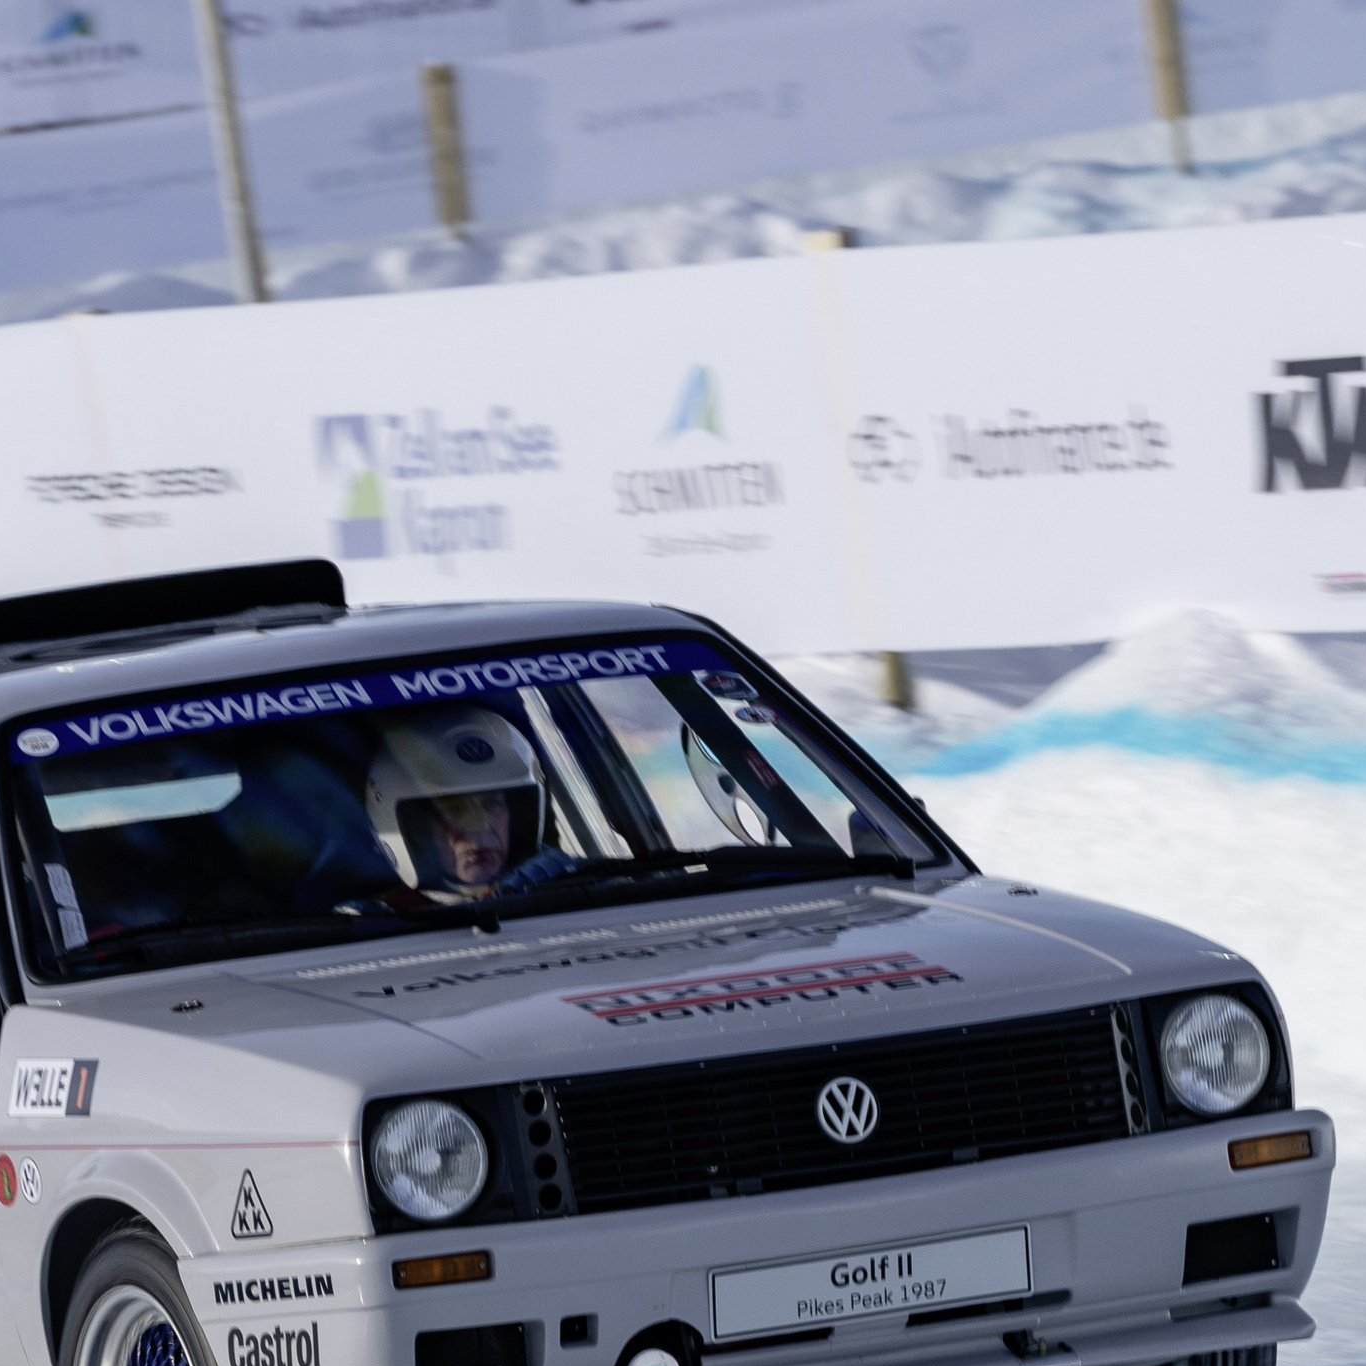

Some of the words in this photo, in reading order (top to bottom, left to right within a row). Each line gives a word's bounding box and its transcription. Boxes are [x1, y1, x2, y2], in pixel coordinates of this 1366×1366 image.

[66, 679, 373, 746] VOLKSWAGEN
[392, 645, 672, 705] MOTORSPORT
[575, 957, 925, 1012] NIXDORF
[605, 971, 963, 1027] COMPUTER
[15, 1067, 68, 1108] WELLE
[213, 1273, 335, 1305] MICHELIN
[830, 1254, 889, 1289] Golf
[897, 1252, 913, 1278] II
[797, 1297, 844, 1319] Pikes
[850, 1286, 893, 1311] Peak
[901, 1278, 946, 1303] 1987
